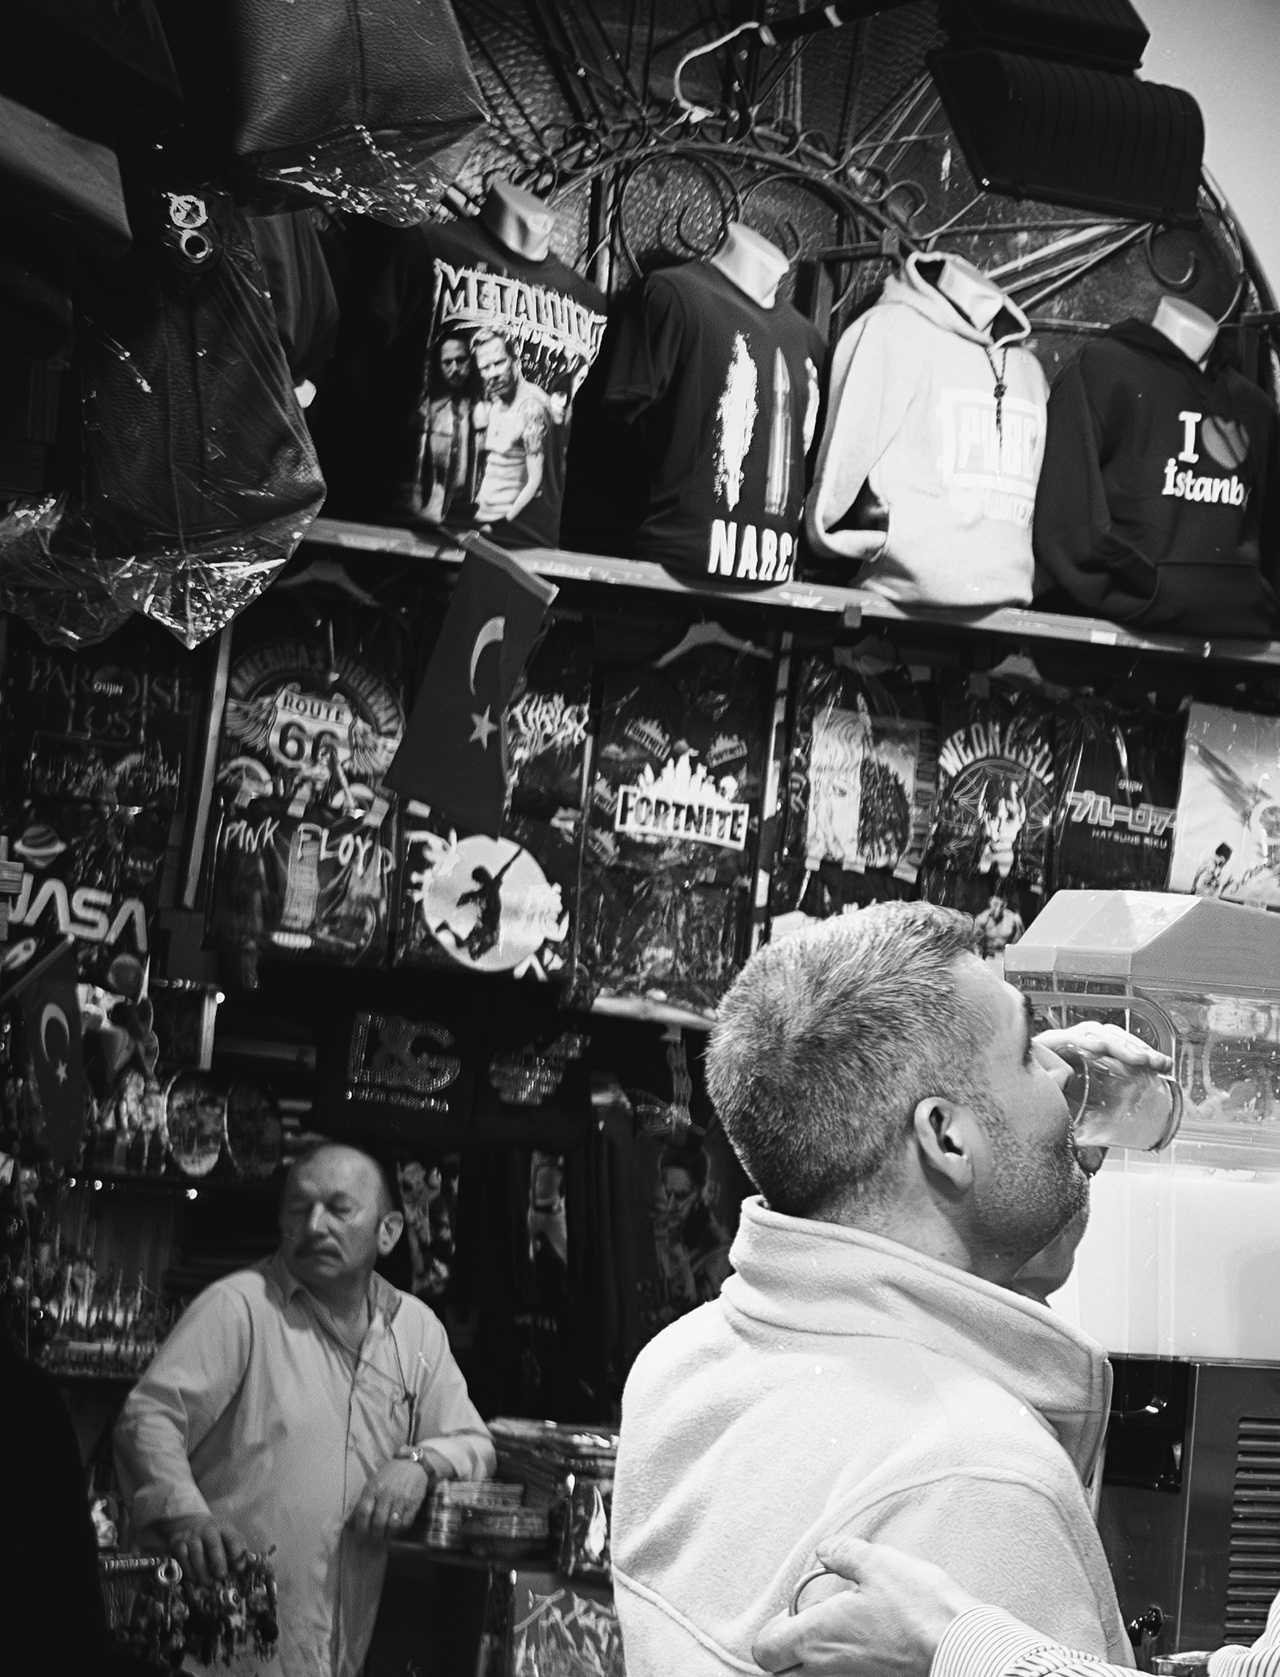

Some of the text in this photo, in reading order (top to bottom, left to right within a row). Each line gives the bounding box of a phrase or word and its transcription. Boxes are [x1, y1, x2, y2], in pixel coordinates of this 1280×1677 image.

[1178, 411, 1201, 463] I
[708, 518, 798, 582] NARC
[224, 816, 280, 853] PINK
[617, 788, 747, 845] FORTNITE
